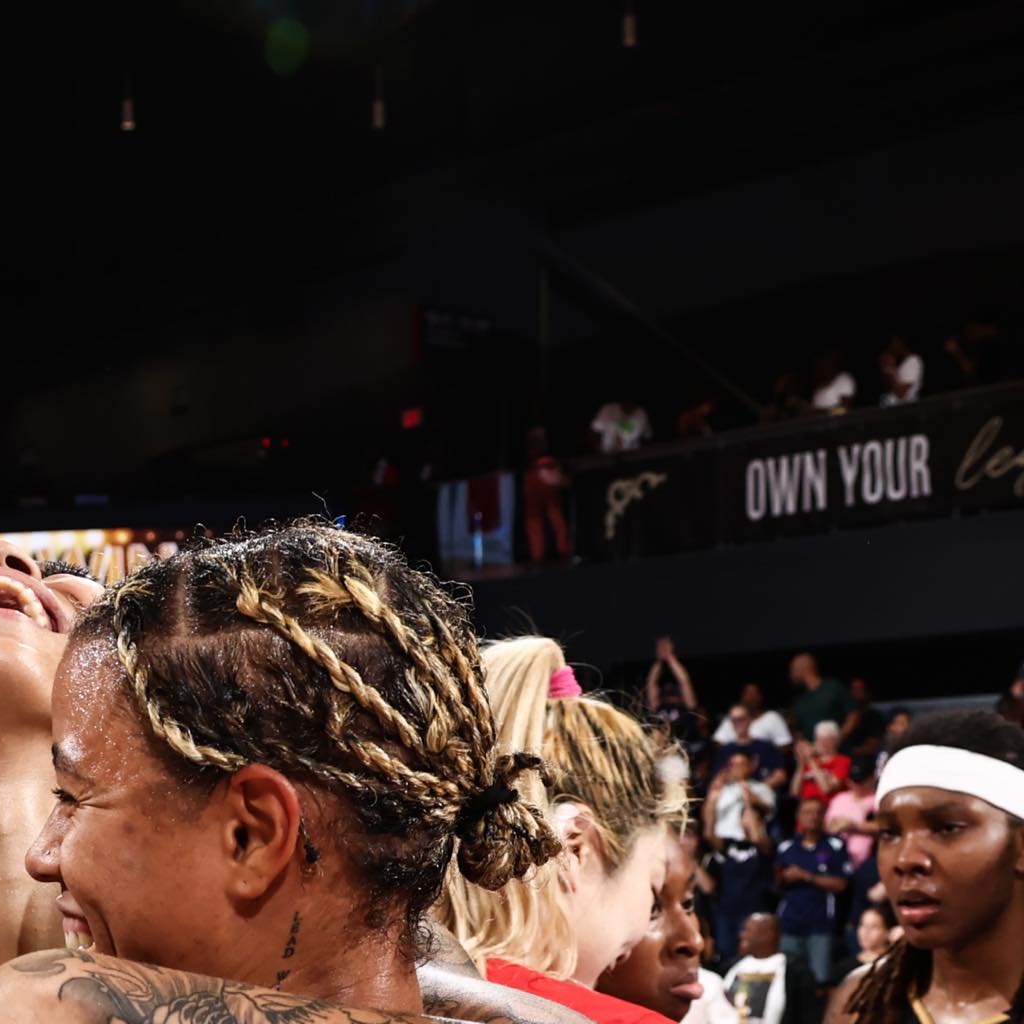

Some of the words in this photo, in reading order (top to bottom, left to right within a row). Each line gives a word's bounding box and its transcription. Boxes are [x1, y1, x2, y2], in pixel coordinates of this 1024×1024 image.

[746, 449, 827, 520] OWN
[838, 434, 931, 506] YOUR
[954, 416, 1024, 497] le
